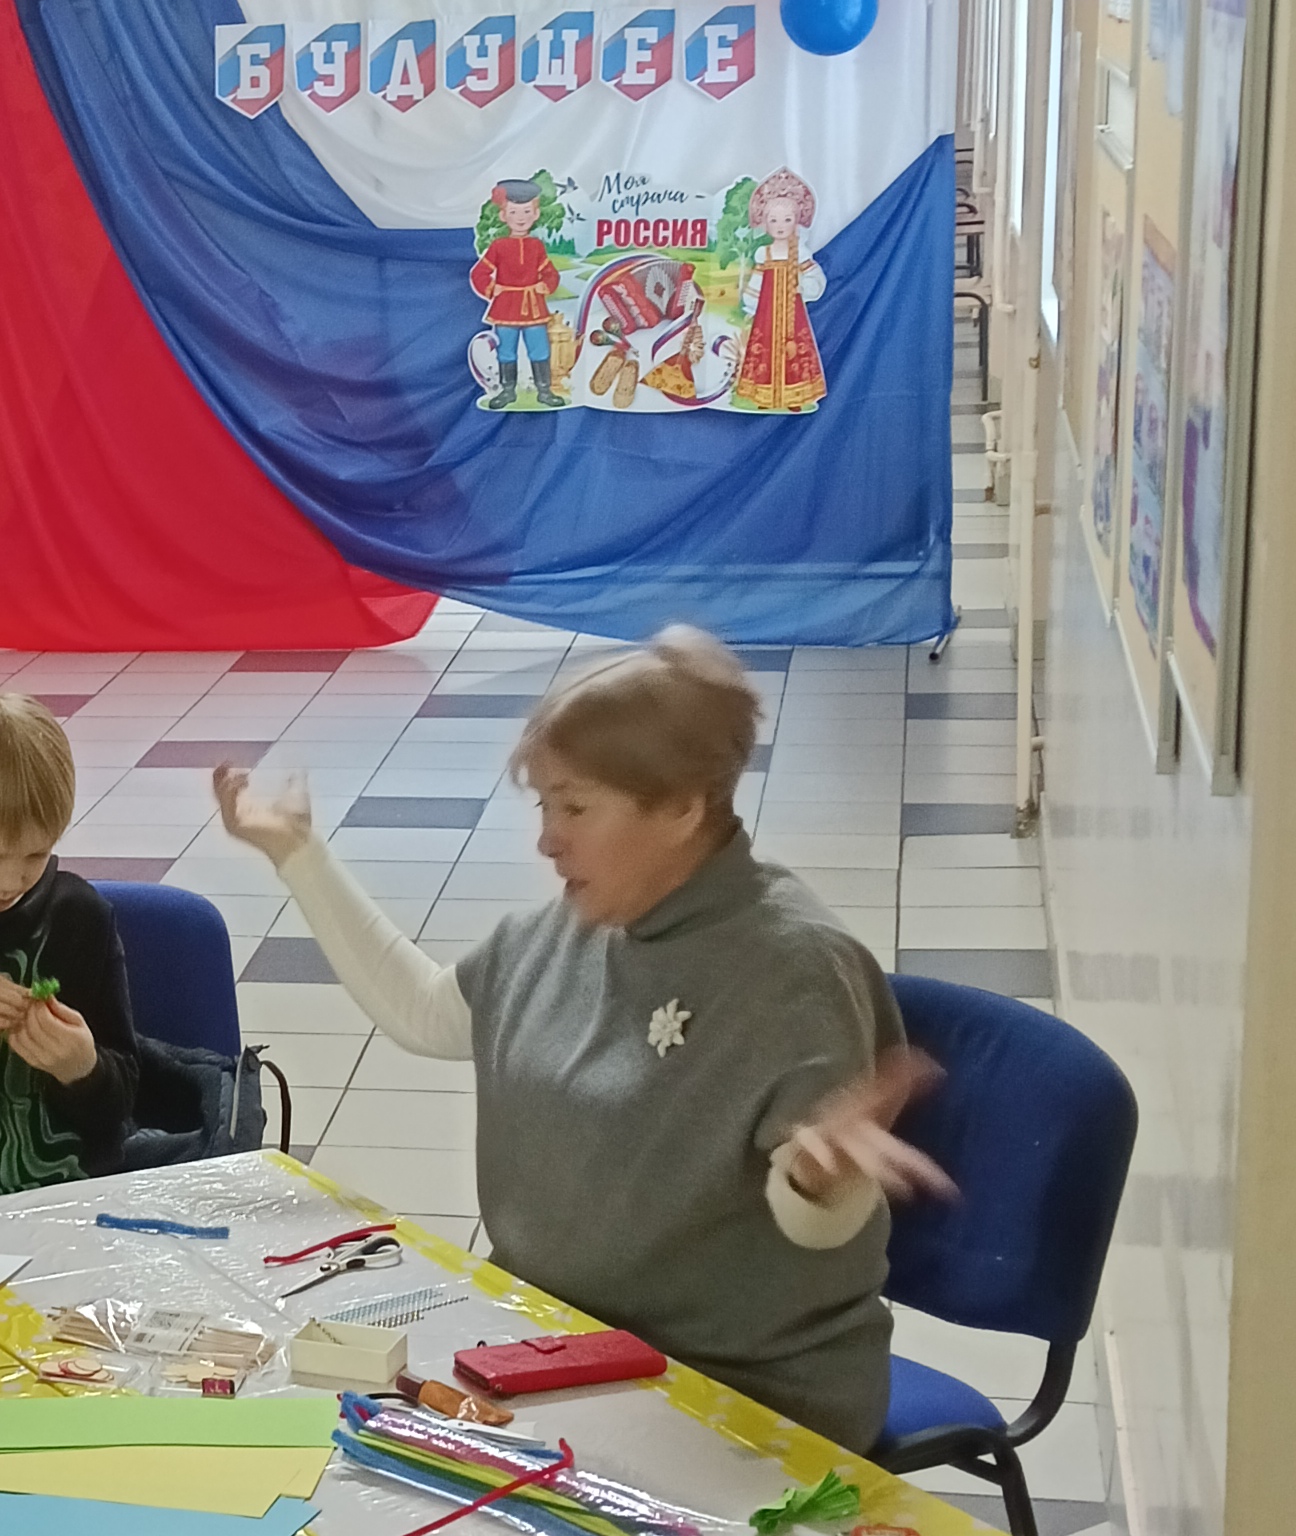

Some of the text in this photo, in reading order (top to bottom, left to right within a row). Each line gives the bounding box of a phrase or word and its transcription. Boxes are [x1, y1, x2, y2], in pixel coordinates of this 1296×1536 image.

[236, 23, 739, 101] БУДУЩЕЕ
[598, 172, 649, 202] Моя
[612, 190, 688, 216] страна
[596, 218, 707, 248] РОССИЯ
